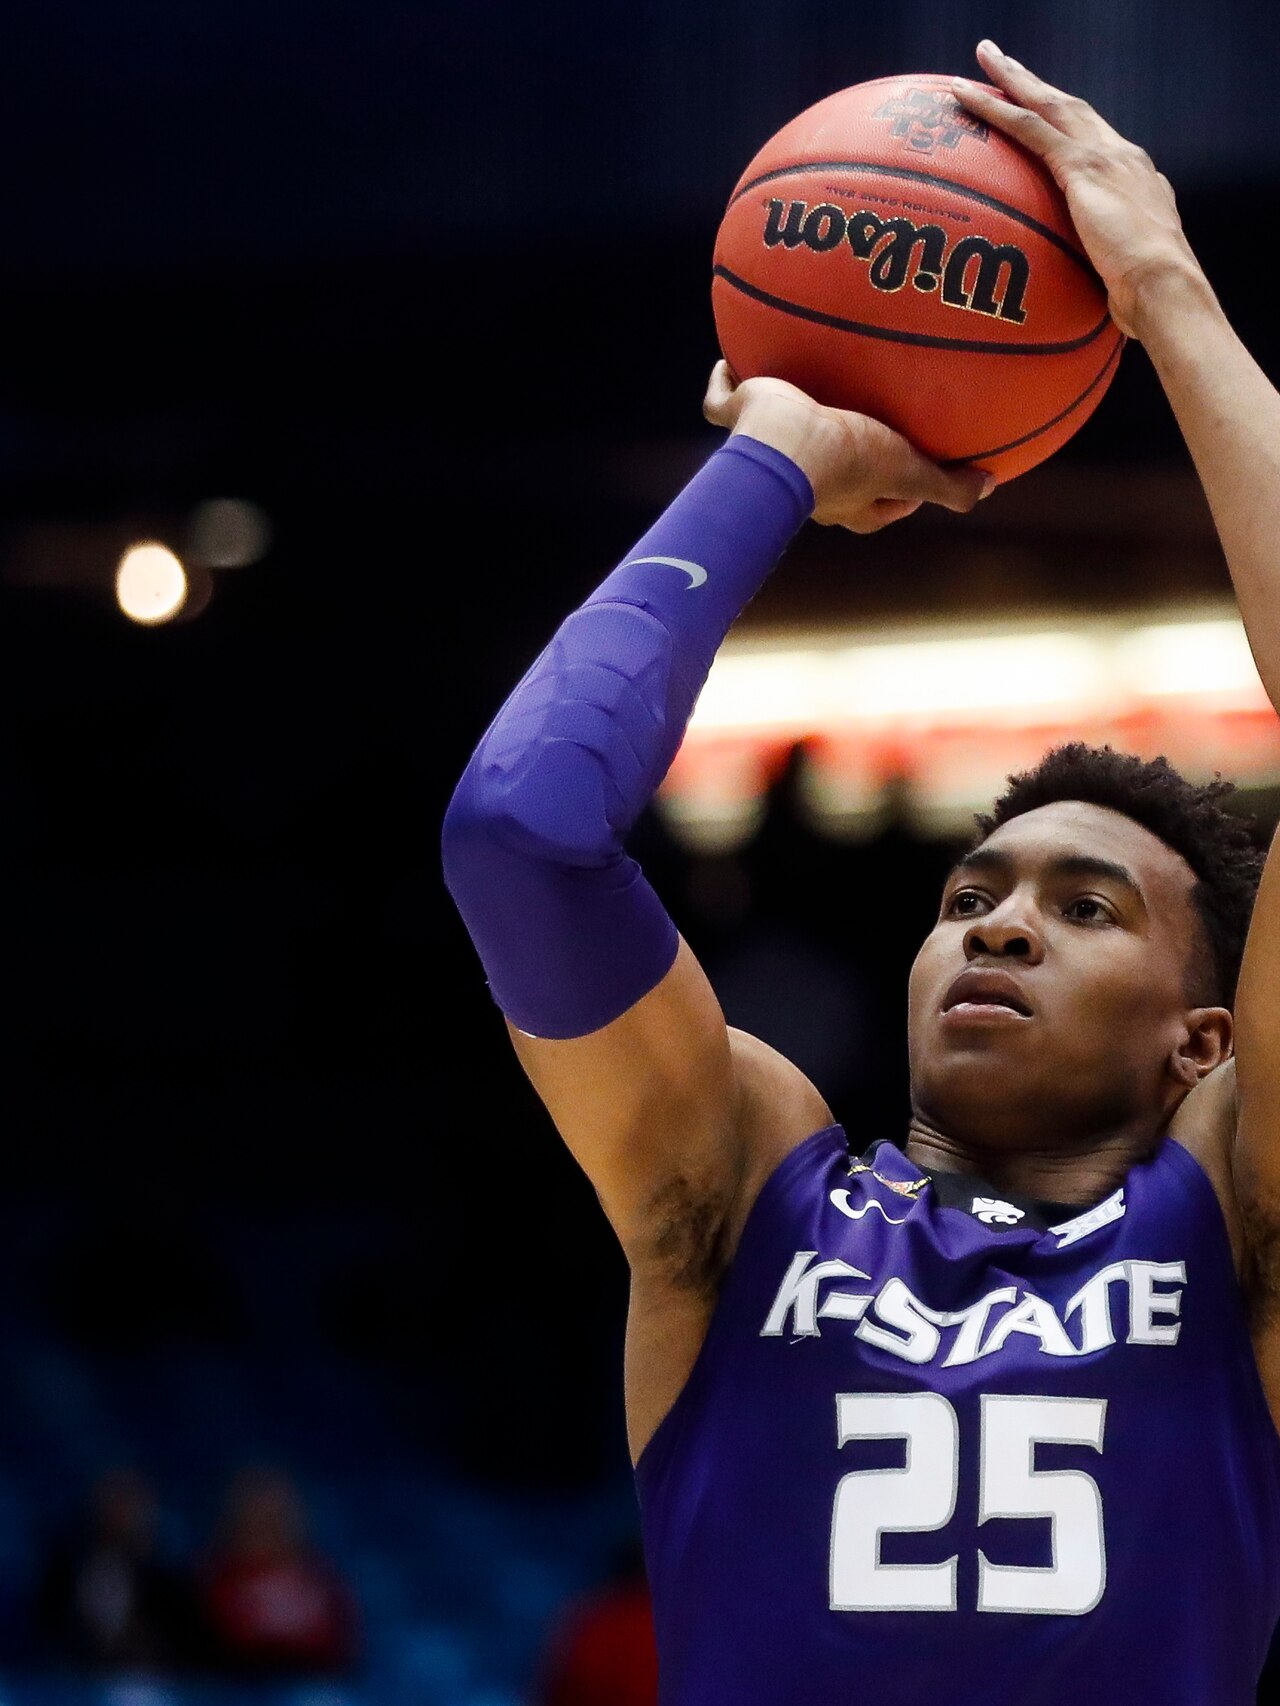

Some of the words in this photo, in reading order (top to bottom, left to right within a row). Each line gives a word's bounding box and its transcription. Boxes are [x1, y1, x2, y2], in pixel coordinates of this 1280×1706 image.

[763, 197, 1030, 325] Wilson
[759, 1250, 1188, 1368] K-STATE
[829, 1391, 1107, 1616] 25
